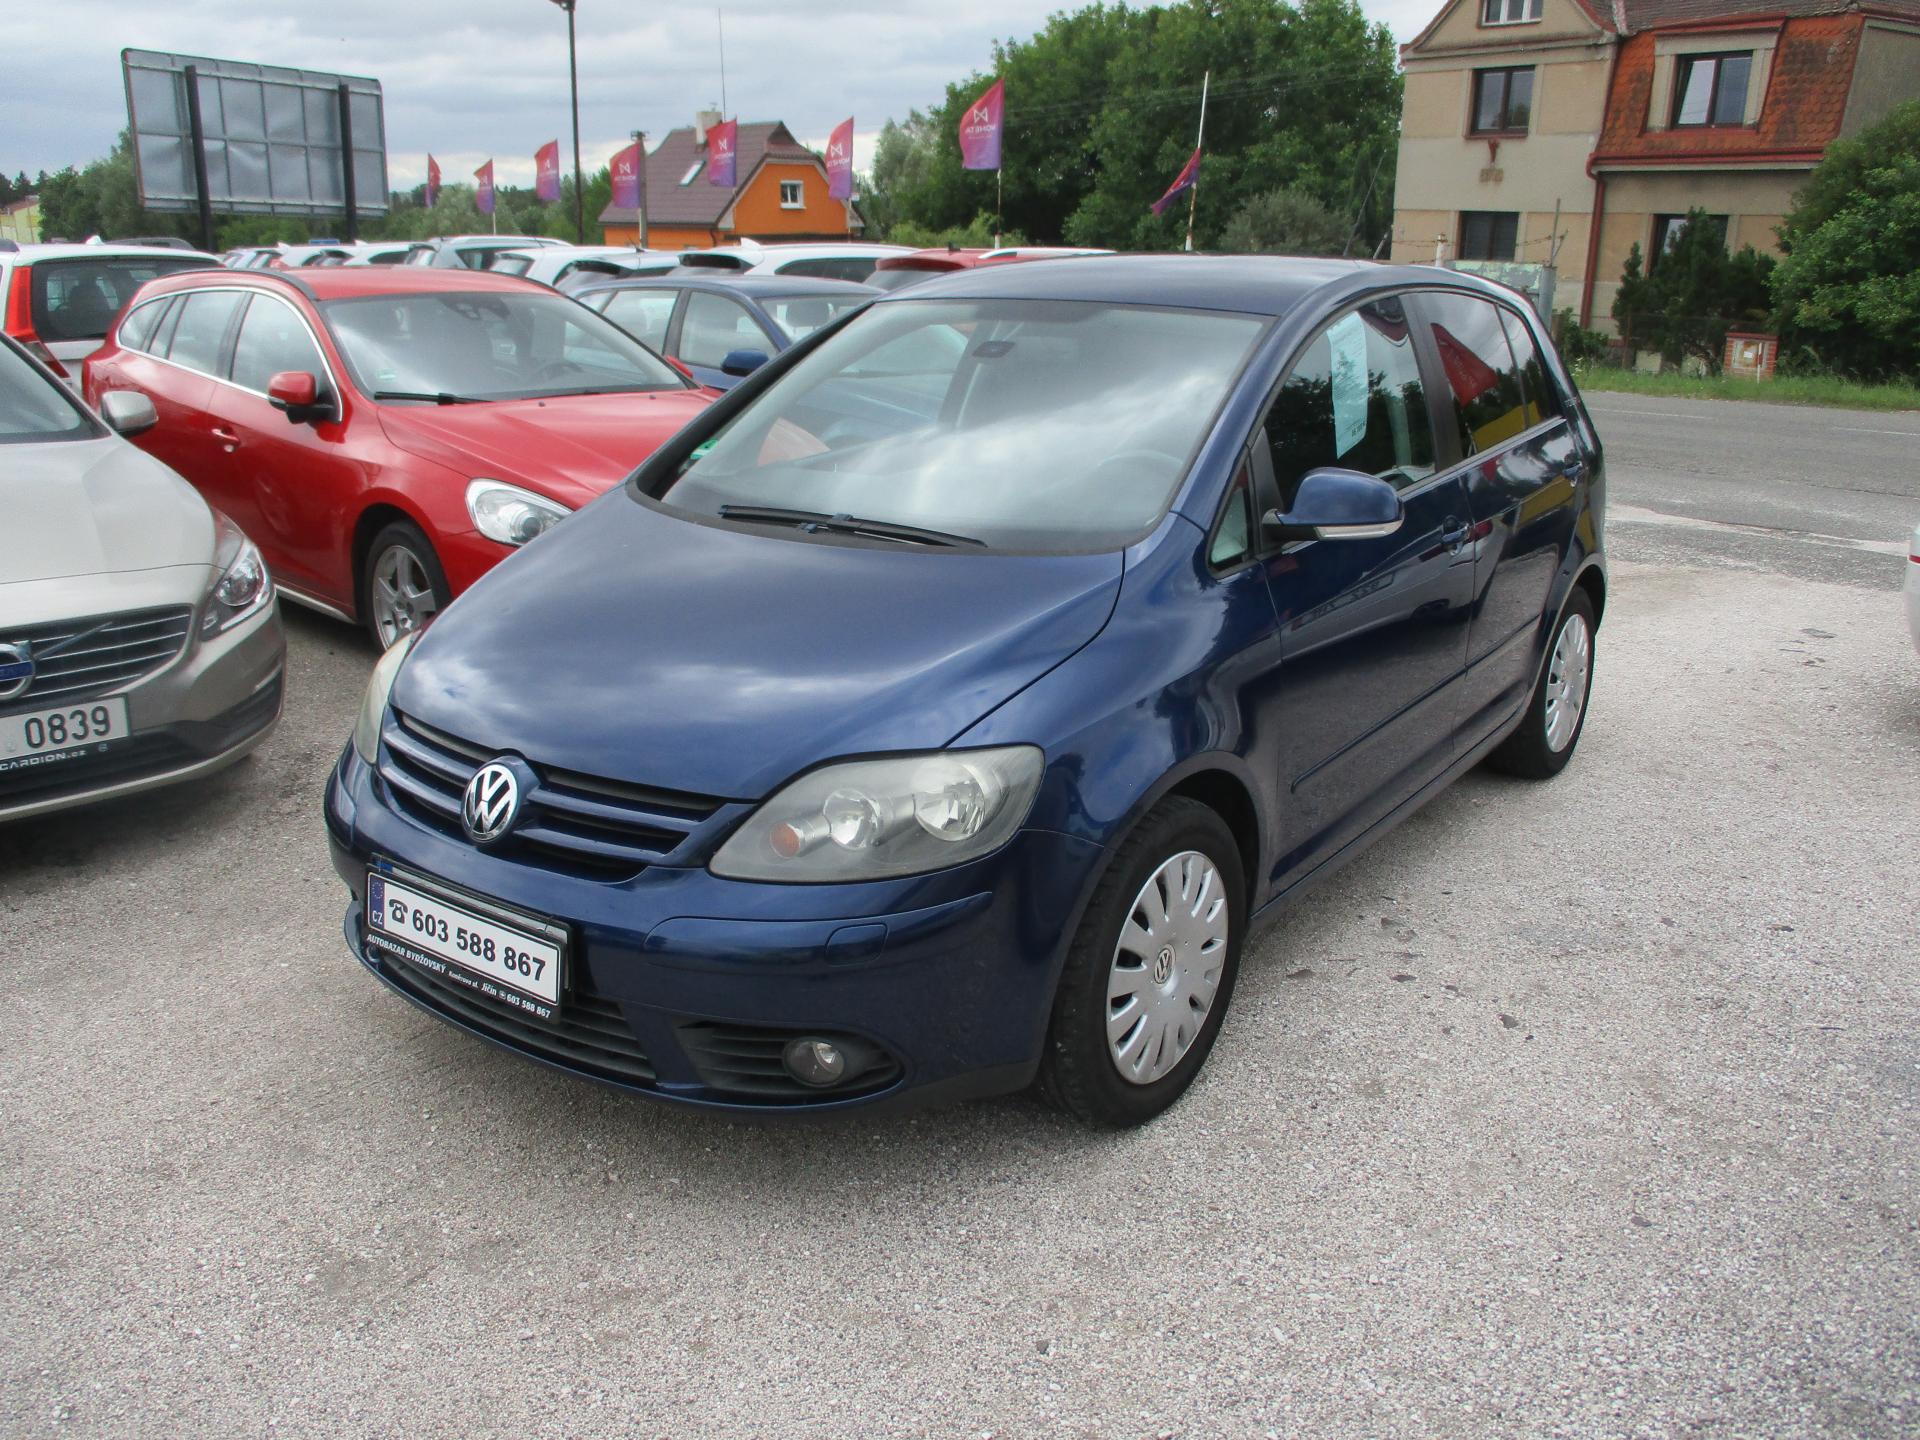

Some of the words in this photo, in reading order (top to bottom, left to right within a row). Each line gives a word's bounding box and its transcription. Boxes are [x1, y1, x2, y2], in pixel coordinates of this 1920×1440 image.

[24, 705, 111, 749] 0839
[371, 910, 384, 926] CZ
[412, 909, 449, 943] 603
[456, 927, 496, 962] 588
[503, 946, 547, 981] 867
[366, 933, 406, 957] AUTOBAZAR
[406, 949, 447, 974] BYDŽOVSKÝ
[481, 982, 497, 996] Jičín
[506, 993, 521, 1006] 603
[521, 1000, 536, 1012] 588
[536, 1006, 551, 1019] 867
